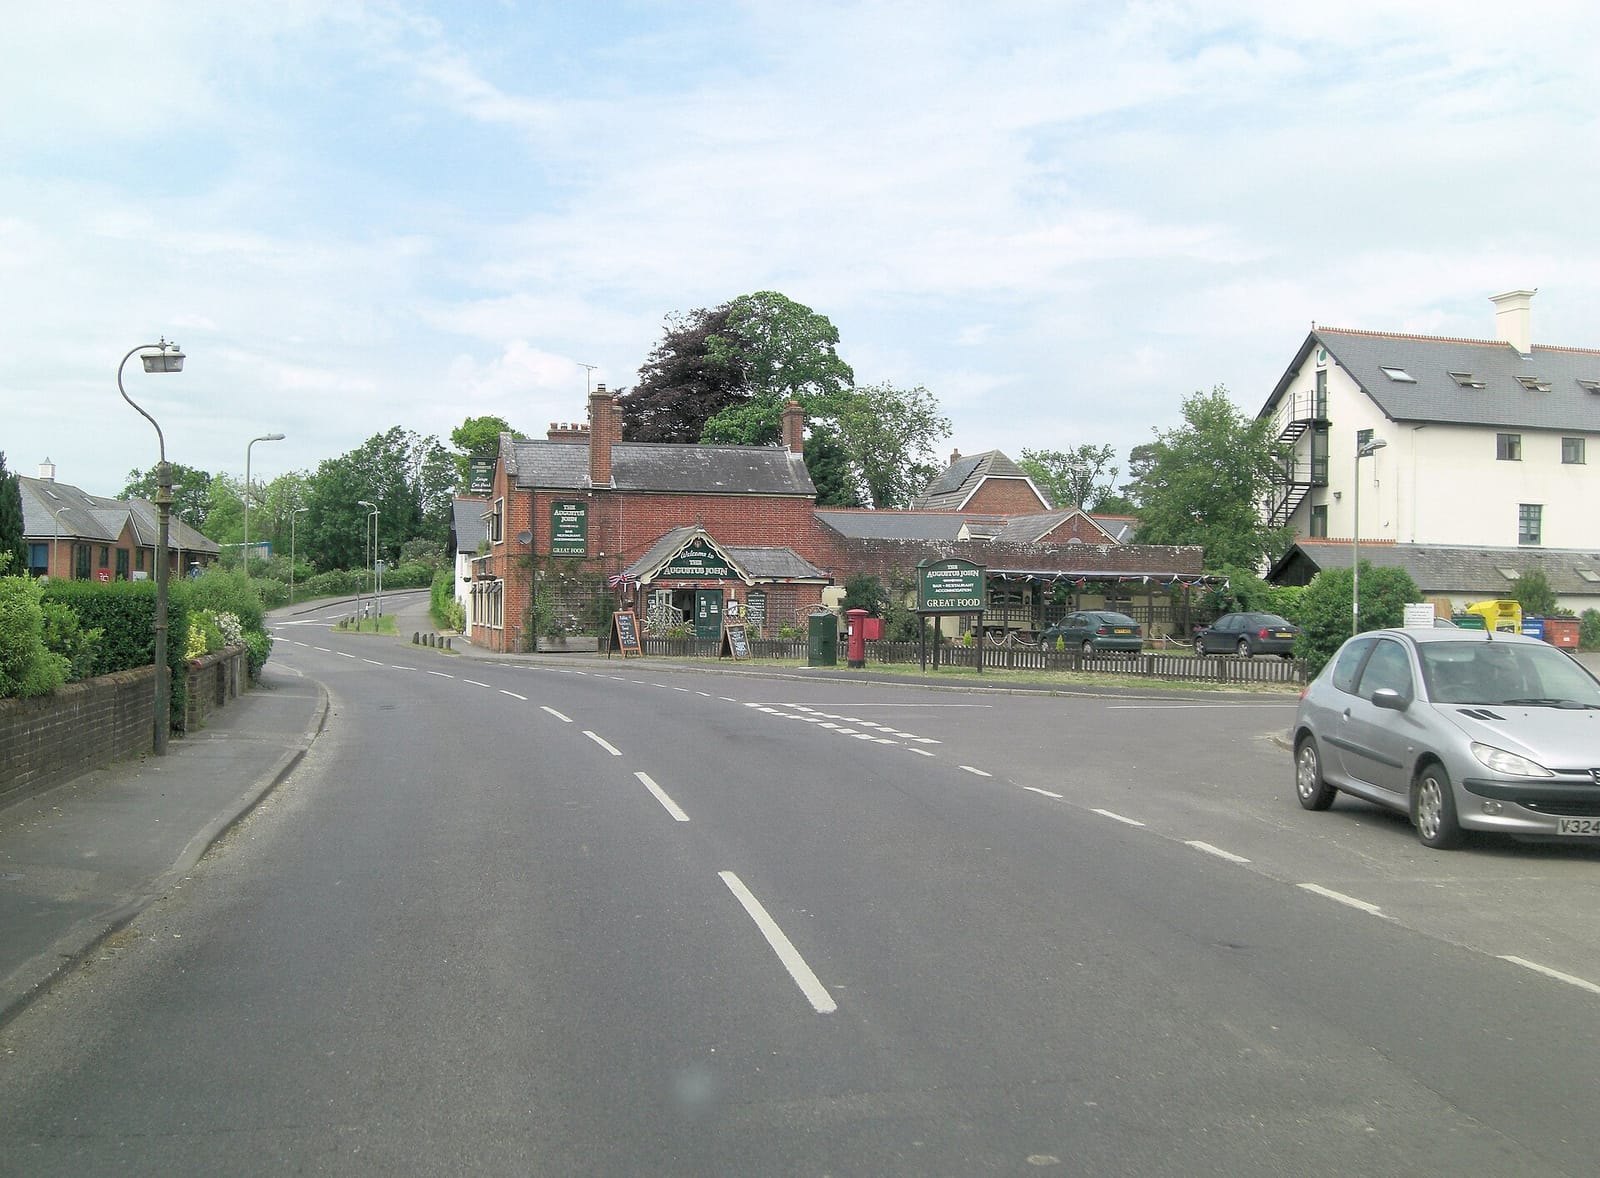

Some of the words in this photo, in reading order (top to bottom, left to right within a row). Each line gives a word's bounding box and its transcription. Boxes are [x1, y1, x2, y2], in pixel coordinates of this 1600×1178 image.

[680, 550, 706, 559] Welcome
[663, 567, 704, 575] AUGUSTUS
[705, 567, 728, 576] JOHN
[926, 570, 960, 578] AUGUSTUS
[960, 569, 979, 578] JOHN
[926, 599, 955, 607] GREAT
[957, 599, 980, 607] FOOD
